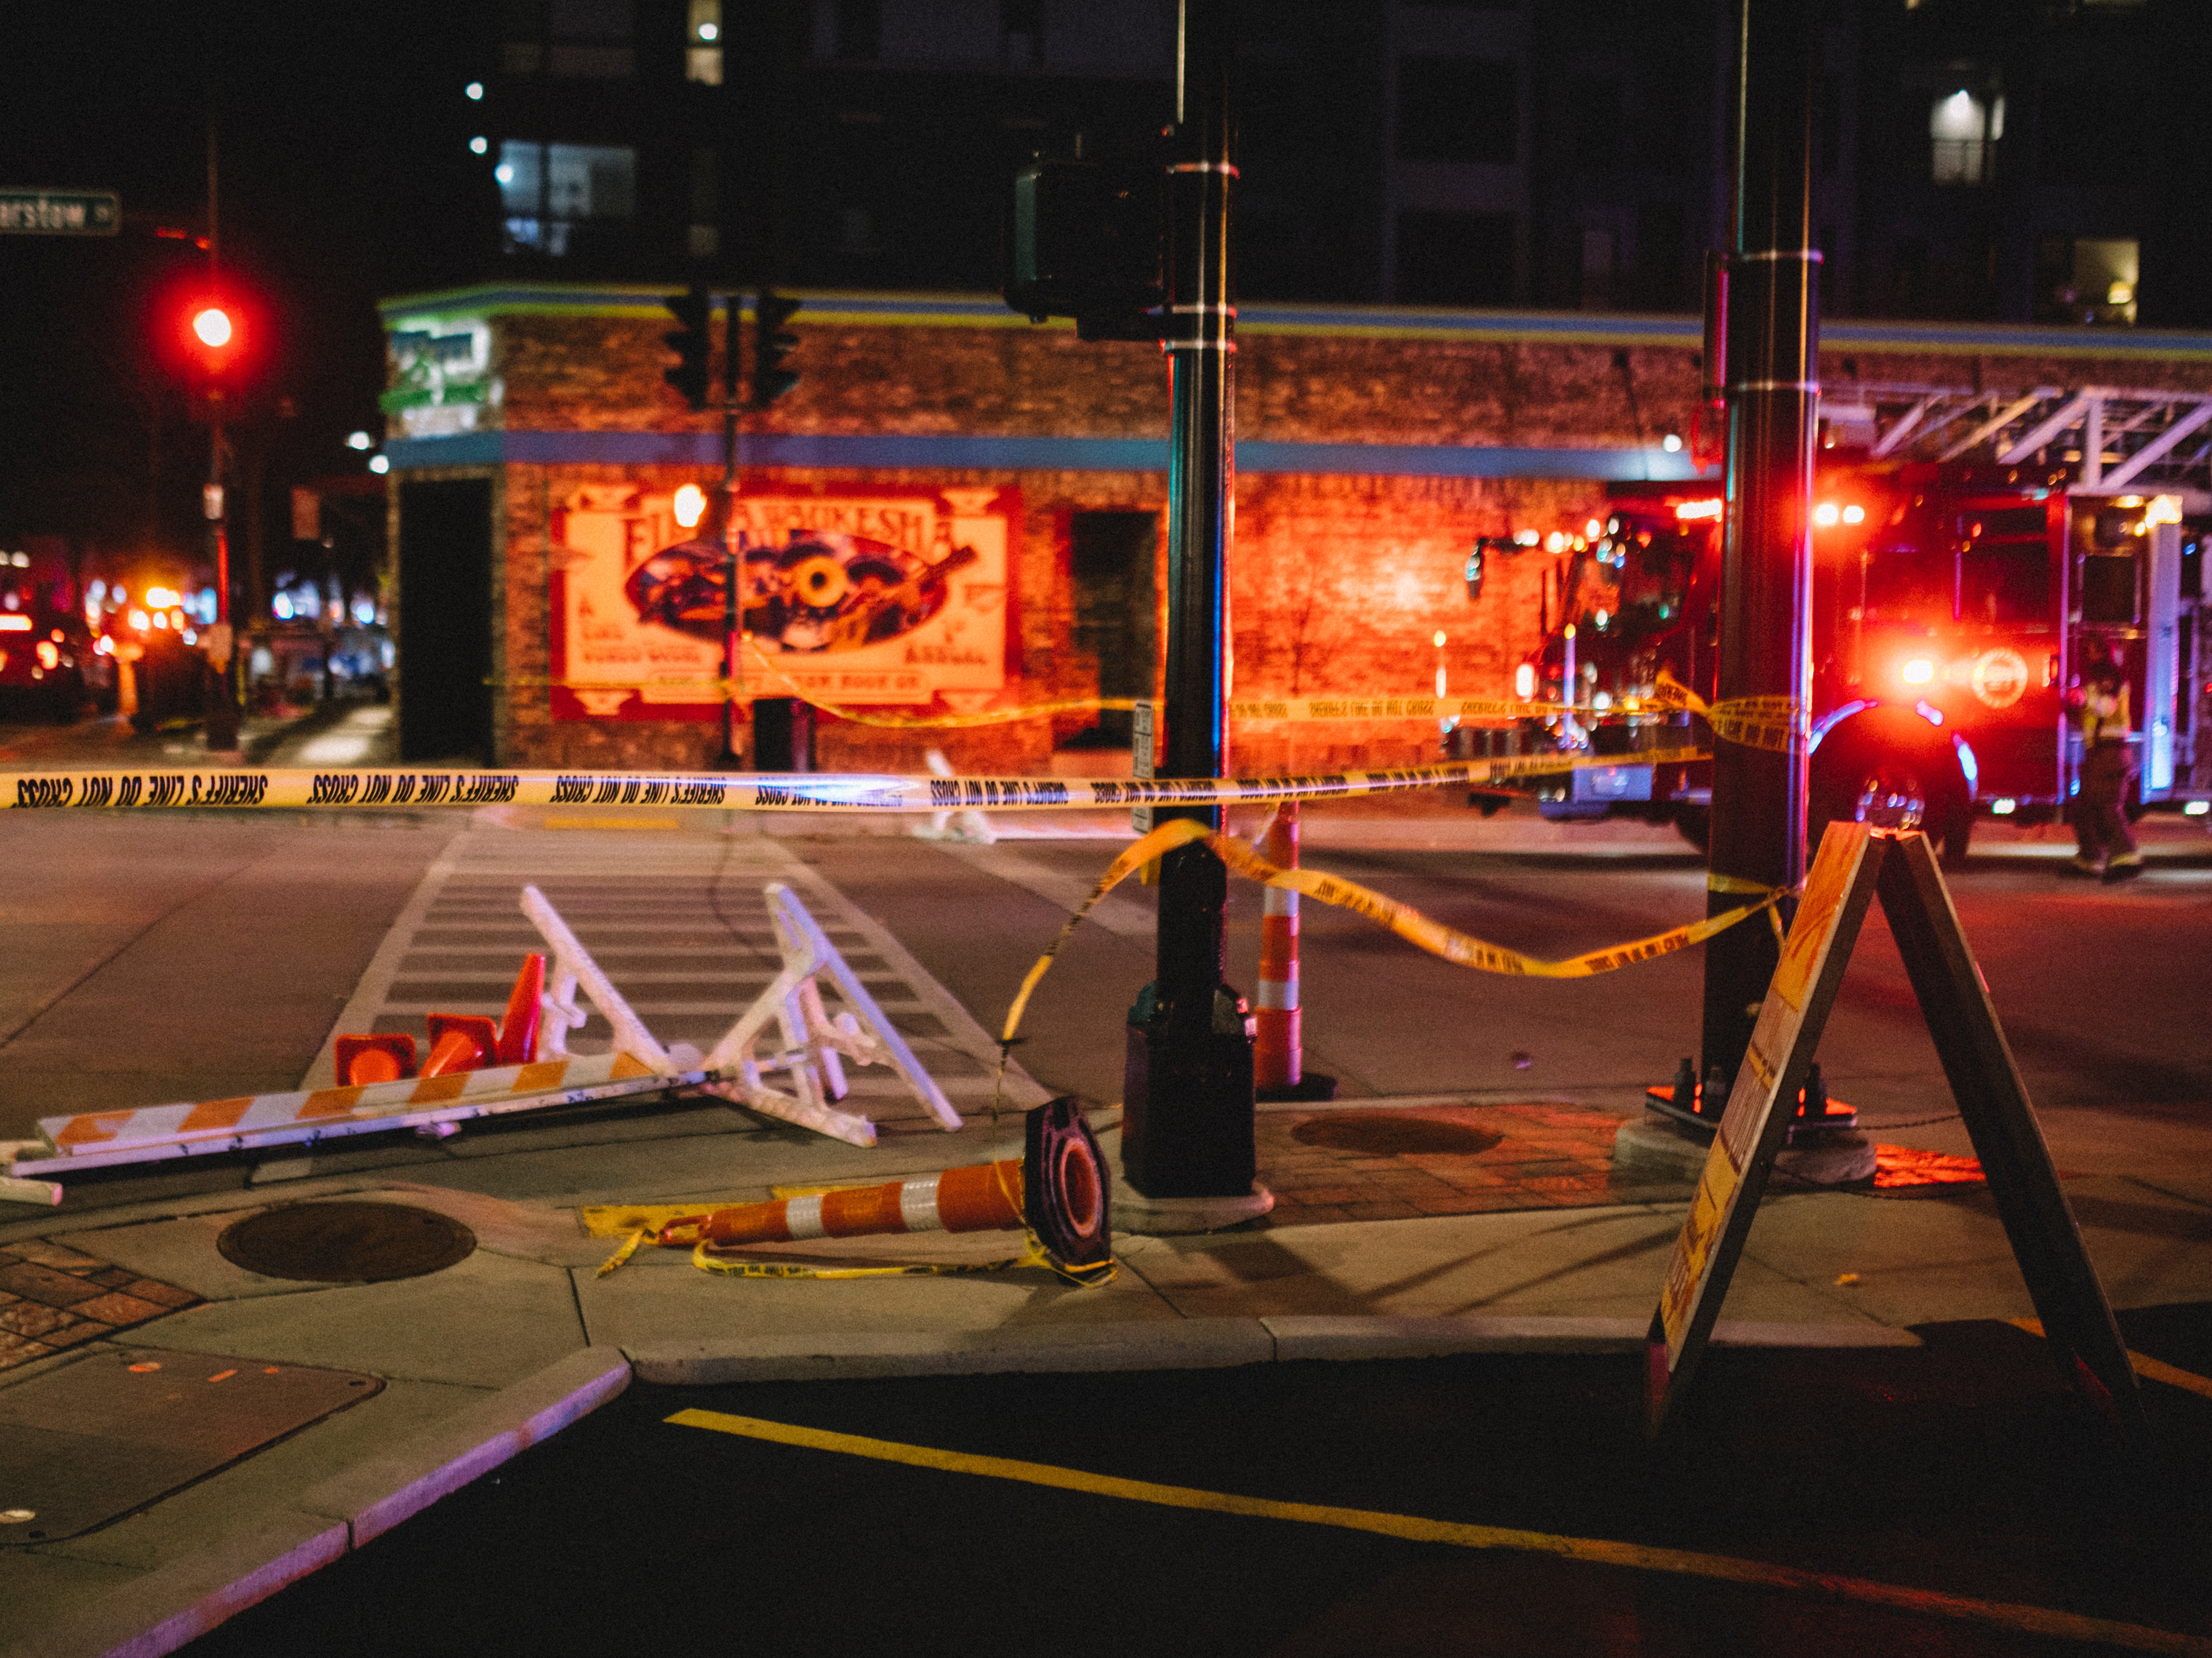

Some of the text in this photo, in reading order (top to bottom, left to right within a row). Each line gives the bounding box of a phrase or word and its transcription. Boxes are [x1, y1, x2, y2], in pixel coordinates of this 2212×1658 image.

[10, 775, 268, 808] SHERIFF'S LINE DO NOT CROSS
[307, 775, 519, 804] SHERIFF'S LINE DO NOT CROSS
[550, 775, 727, 804] SHERIFF'S LINE DO NOT CROSS
[756, 777, 789, 805] CROSS
[930, 780, 961, 805] CROSS
[964, 780, 983, 805] NOT
[985, 780, 999, 805] DO
